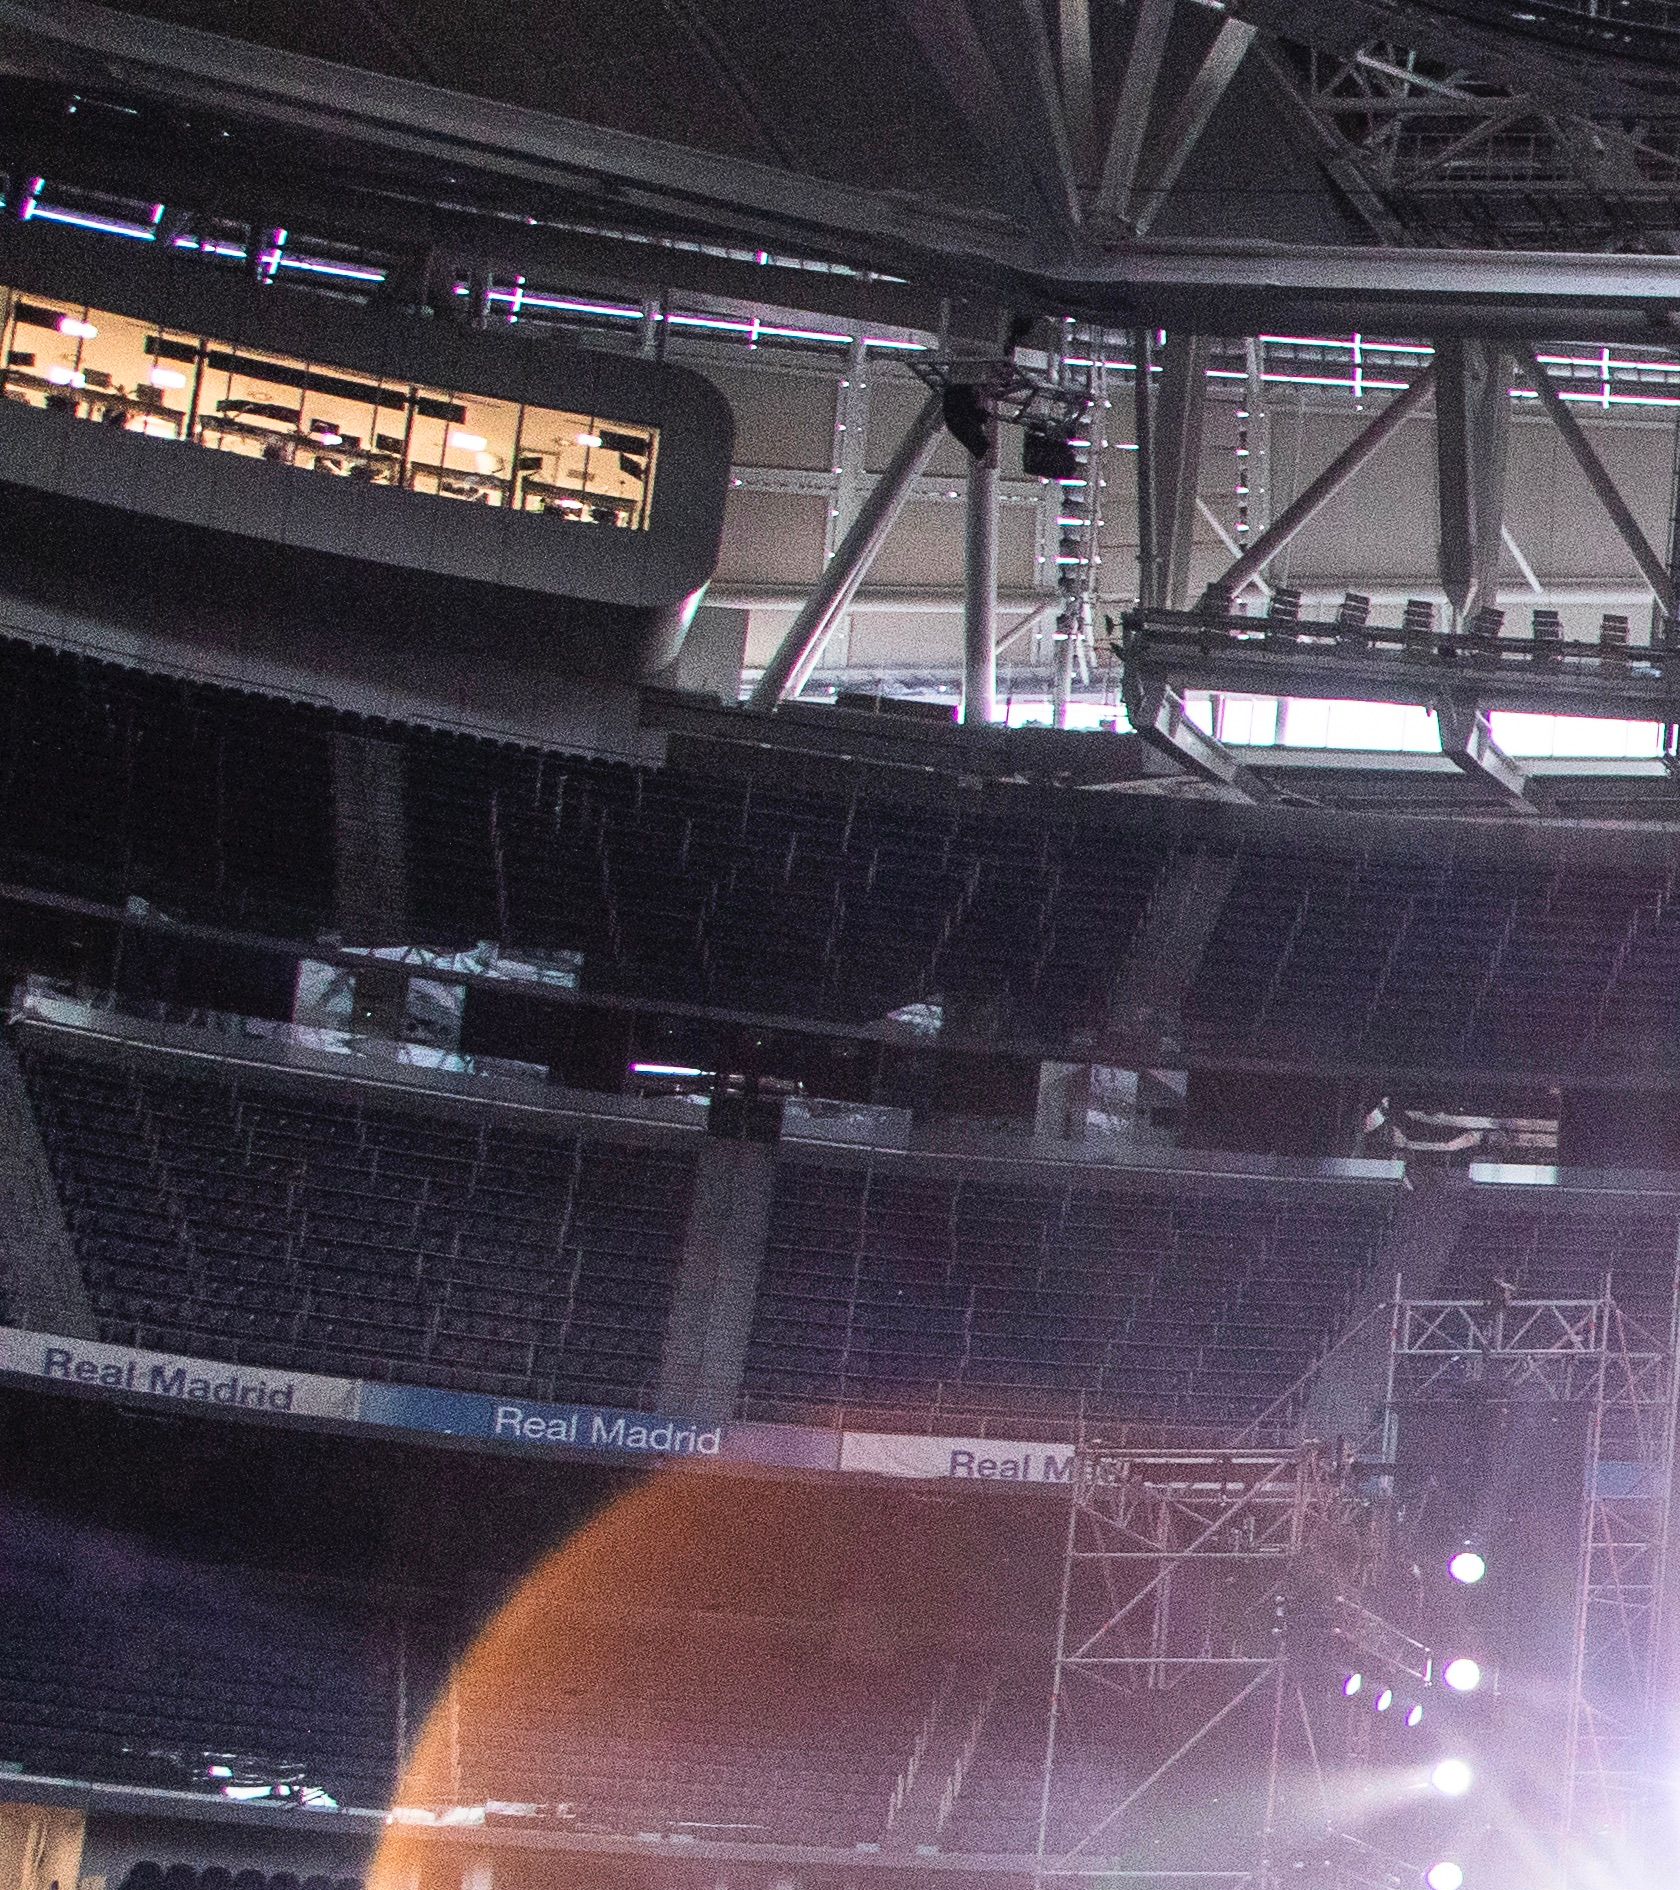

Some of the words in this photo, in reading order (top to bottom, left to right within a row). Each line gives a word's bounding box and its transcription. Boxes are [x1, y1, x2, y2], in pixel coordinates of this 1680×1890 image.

[44, 1347, 136, 1390] Real
[150, 1364, 295, 1412] Madrid
[495, 1405, 578, 1442] Real
[591, 1416, 722, 1455] Madrid
[950, 1449, 1031, 1481] Real
